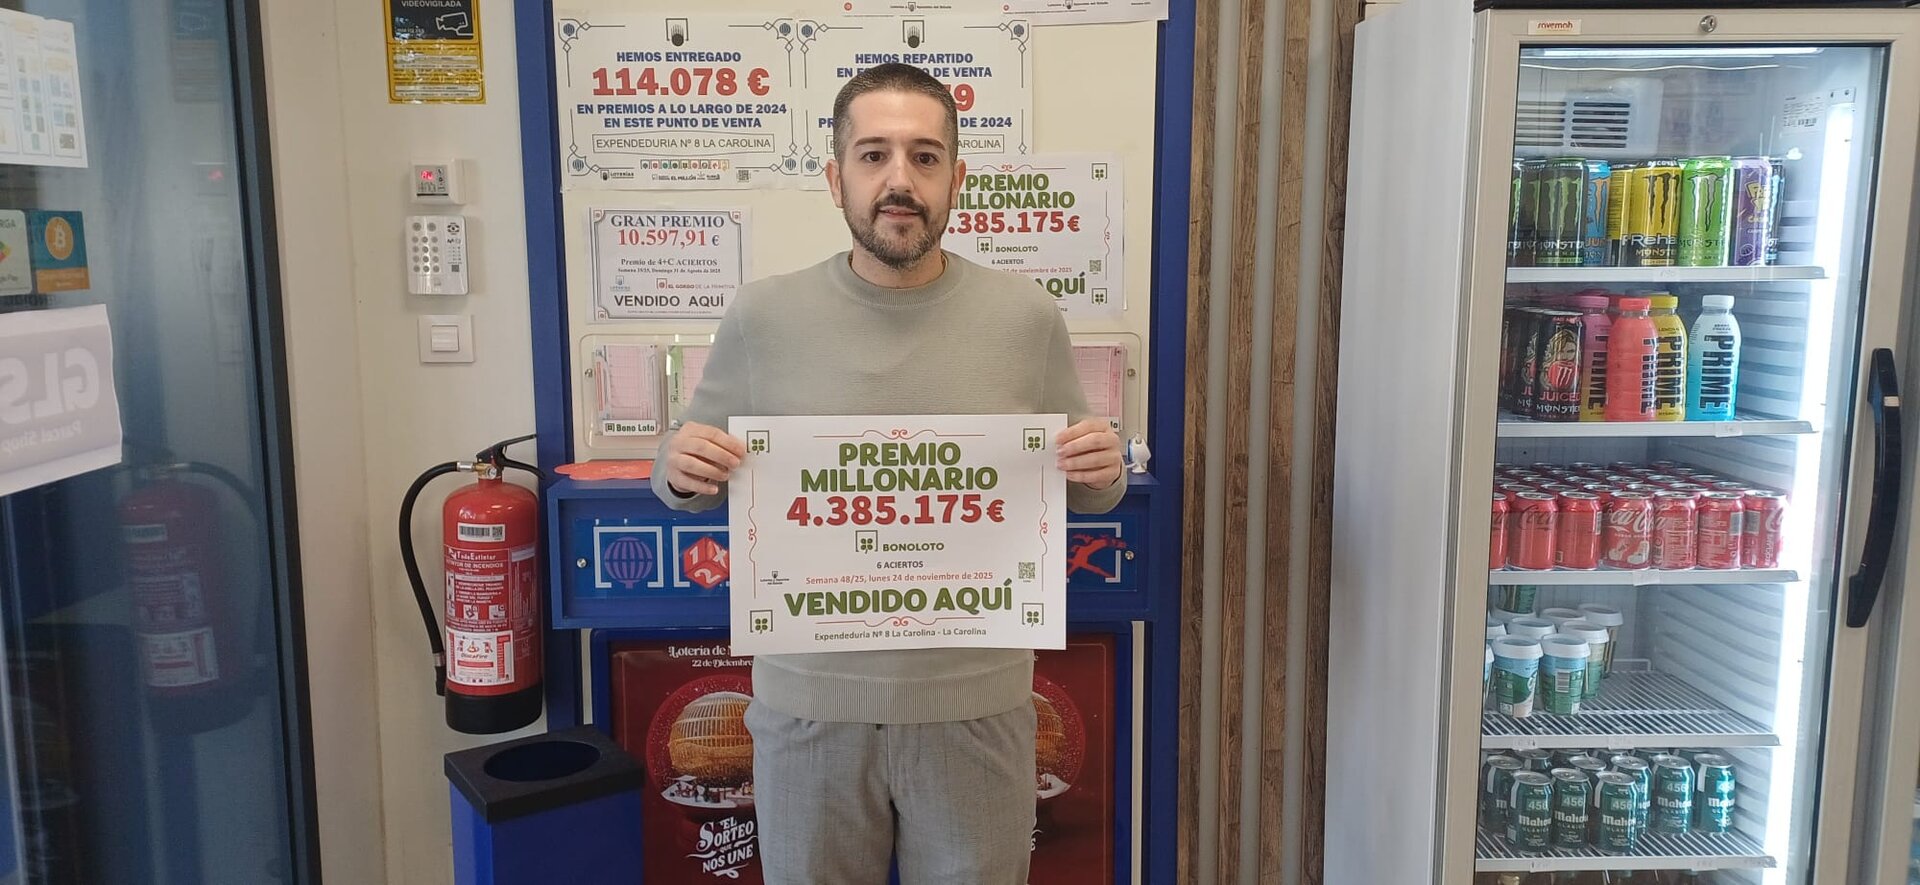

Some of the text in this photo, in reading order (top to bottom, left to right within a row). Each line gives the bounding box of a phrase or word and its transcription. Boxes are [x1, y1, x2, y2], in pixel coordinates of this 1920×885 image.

[616, 52, 741, 62] HEMOS ENTREGADO
[855, 53, 973, 64] HEMOS REPARTIDO
[837, 67, 853, 77] EN
[934, 68, 950, 77] DE
[953, 67, 992, 77] VENTA
[592, 67, 770, 96] 114.078 €
[577, 103, 787, 115] EN PREMIOS A LO LARGO DE 2024
[604, 117, 762, 128] EN ESTE PUNTO DE VENTA
[960, 117, 1012, 128] DE 2024
[596, 139, 677, 148] EXPENDEDURIA
[694, 138, 700, 148] 8
[703, 138, 718, 148] LA
[720, 138, 771, 148] CAROLINA
[958, 139, 1001, 148] AROLINA
[965, 174, 1049, 192] PREMIO
[611, 214, 725, 228] GRAN PREMIO
[618, 229, 720, 249] 10.597,91 €
[621, 258, 646, 266] Premio
[676, 258, 718, 266] ACIERTOS
[614, 293, 724, 308] VENDIDO AQUÍ
[1700, 335, 1735, 409] PRIME
[616, 423, 655, 432] Bono Loto
[838, 442, 961, 467] PREMIO
[800, 467, 998, 492] MILLONARIO
[882, 543, 945, 552] BONOLOTO
[884, 561, 924, 569] ACIERTOS
[806, 572, 994, 585] Semana 48/25, lunes 24 de noviembre de 2025
[784, 578, 1013, 617] VENDIDO AQUÍ
[892, 630, 901, 638] La
[903, 629, 936, 637] Carolina
[942, 628, 952, 636] La
[953, 627, 987, 636] Carolina
[712, 645, 726, 656] de
[702, 659, 712, 667] de
[720, 816, 737, 829] EL
[703, 844, 753, 873] NOS UNE
